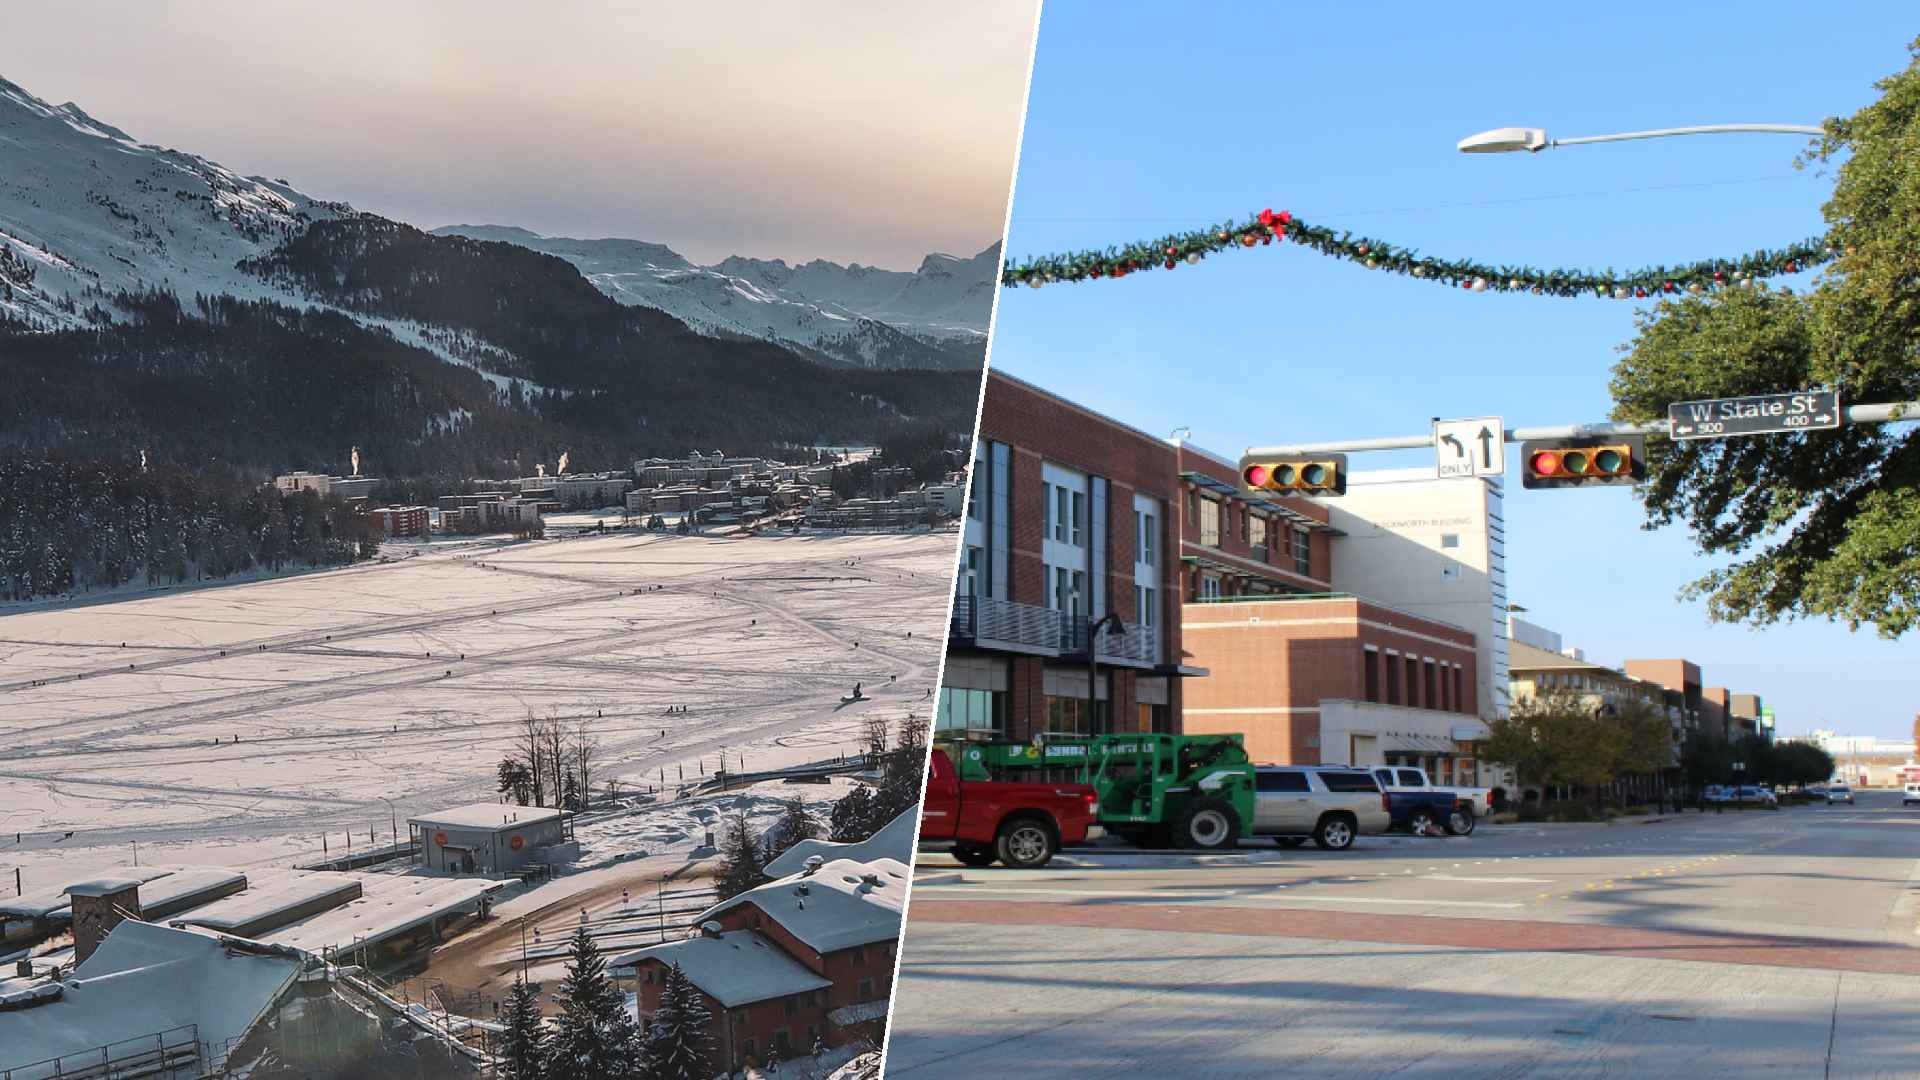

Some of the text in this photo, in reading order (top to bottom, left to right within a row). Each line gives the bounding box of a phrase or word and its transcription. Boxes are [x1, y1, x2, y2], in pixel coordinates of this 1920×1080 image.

[1690, 395, 1817, 422] W State St
[1784, 415, 1809, 427] 400
[1441, 463, 1472, 475] ONLY
